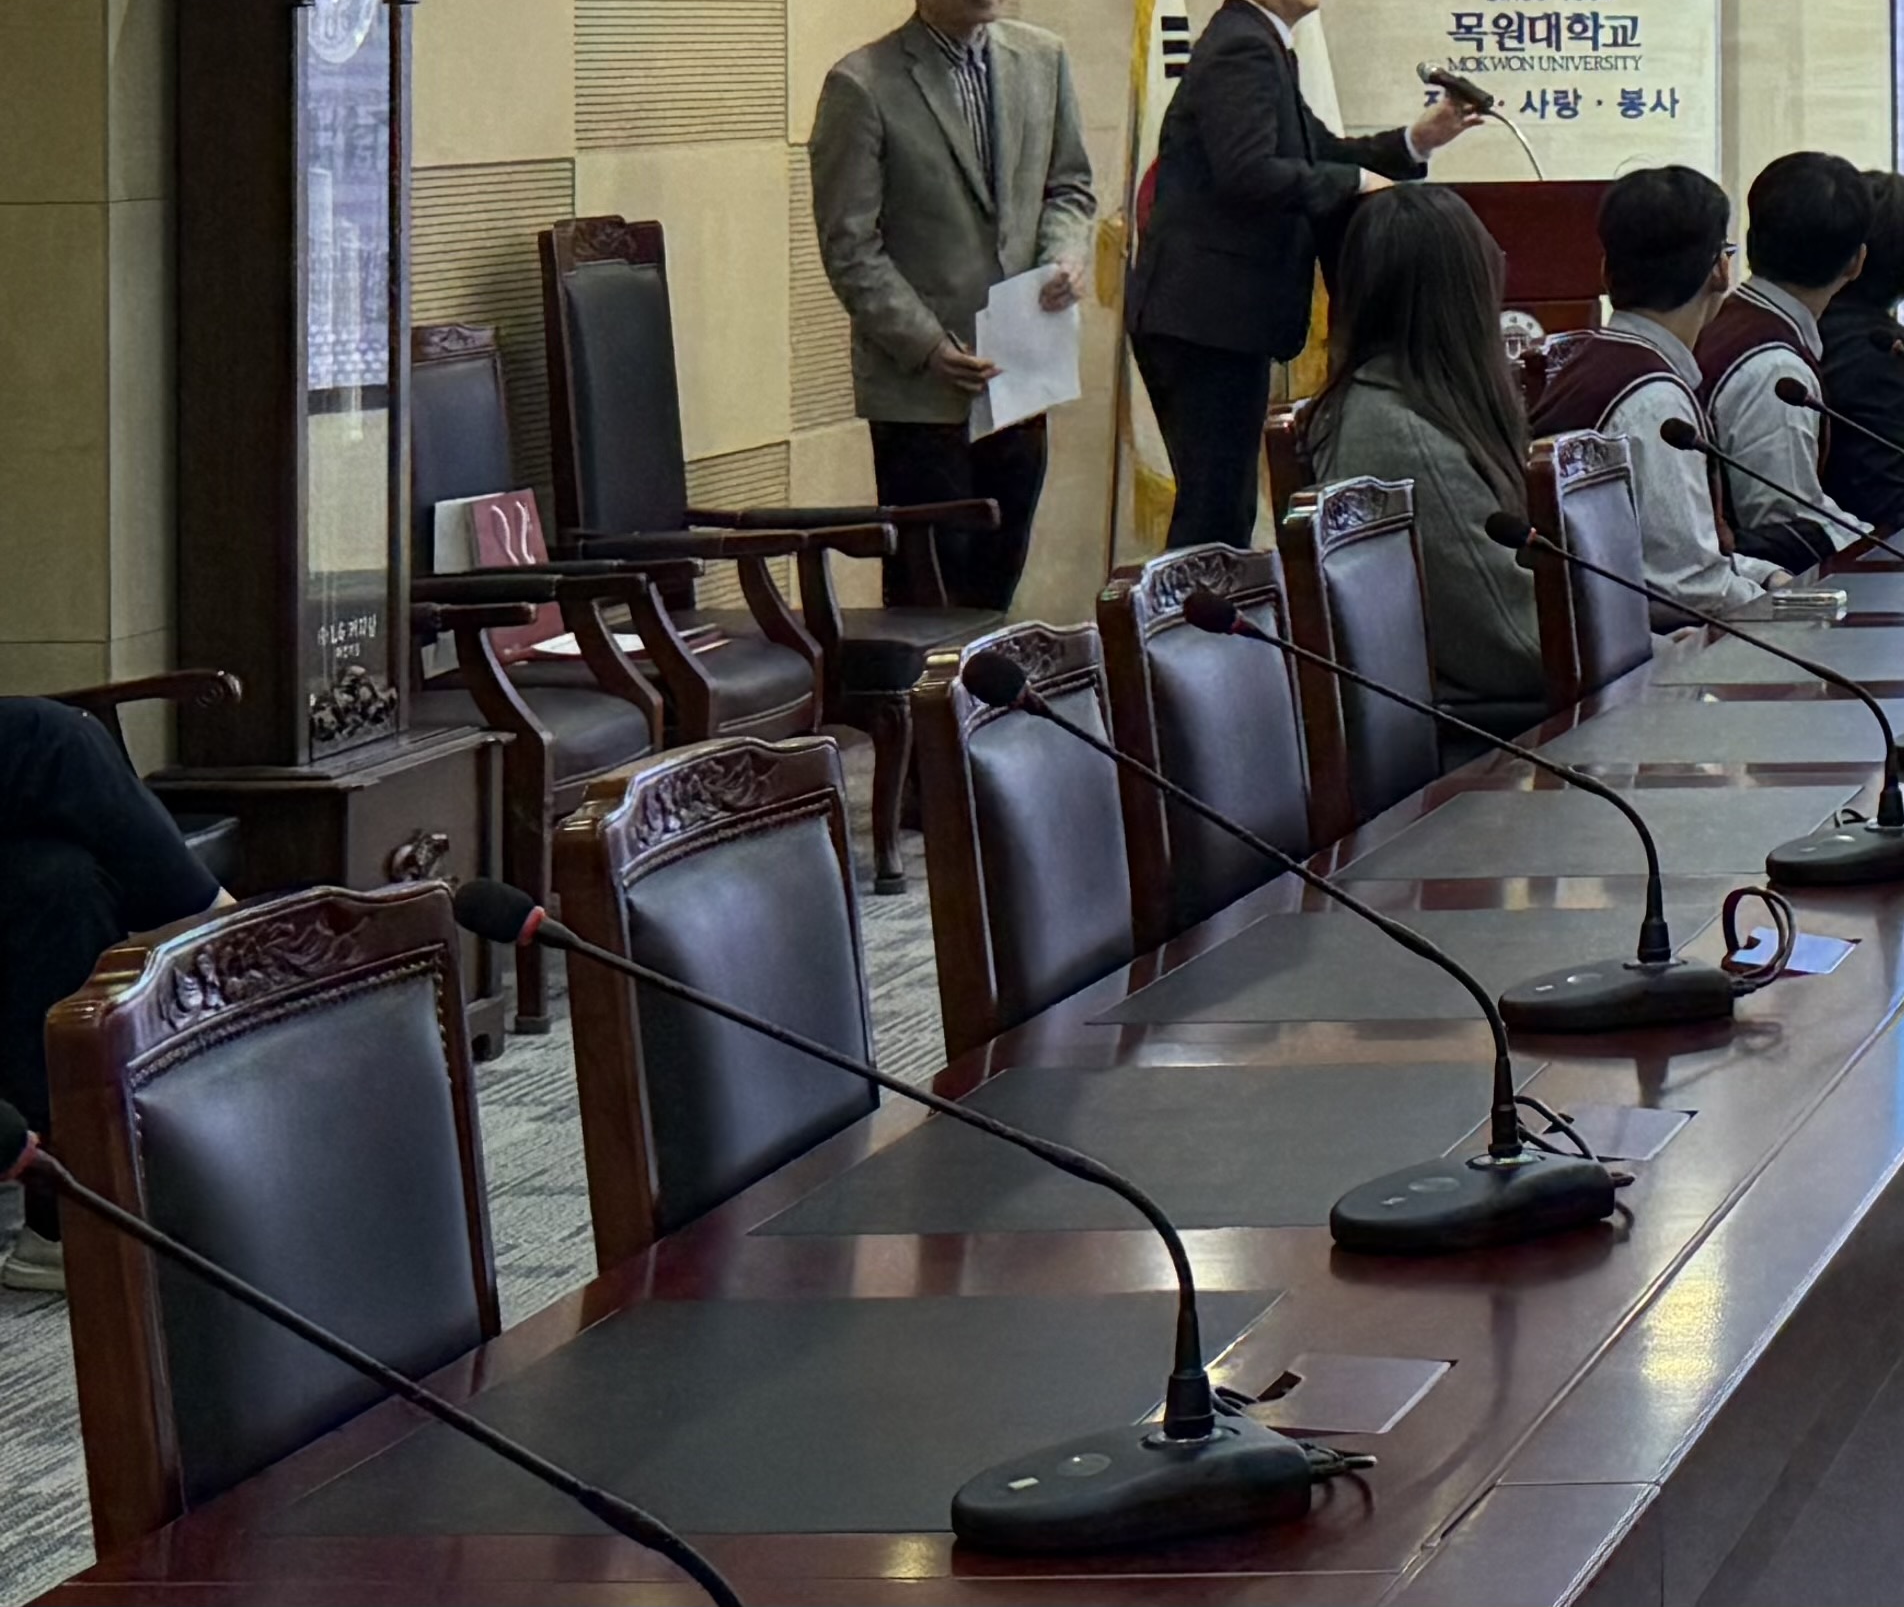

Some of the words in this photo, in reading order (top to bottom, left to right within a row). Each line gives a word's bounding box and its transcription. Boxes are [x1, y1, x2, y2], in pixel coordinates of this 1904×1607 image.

[1446, 10, 1642, 52] 목원대학교
[1537, 54, 1644, 72] UNIVERSITY
[1519, 87, 1583, 120] 사랑
[1616, 87, 1680, 119] 봉사
